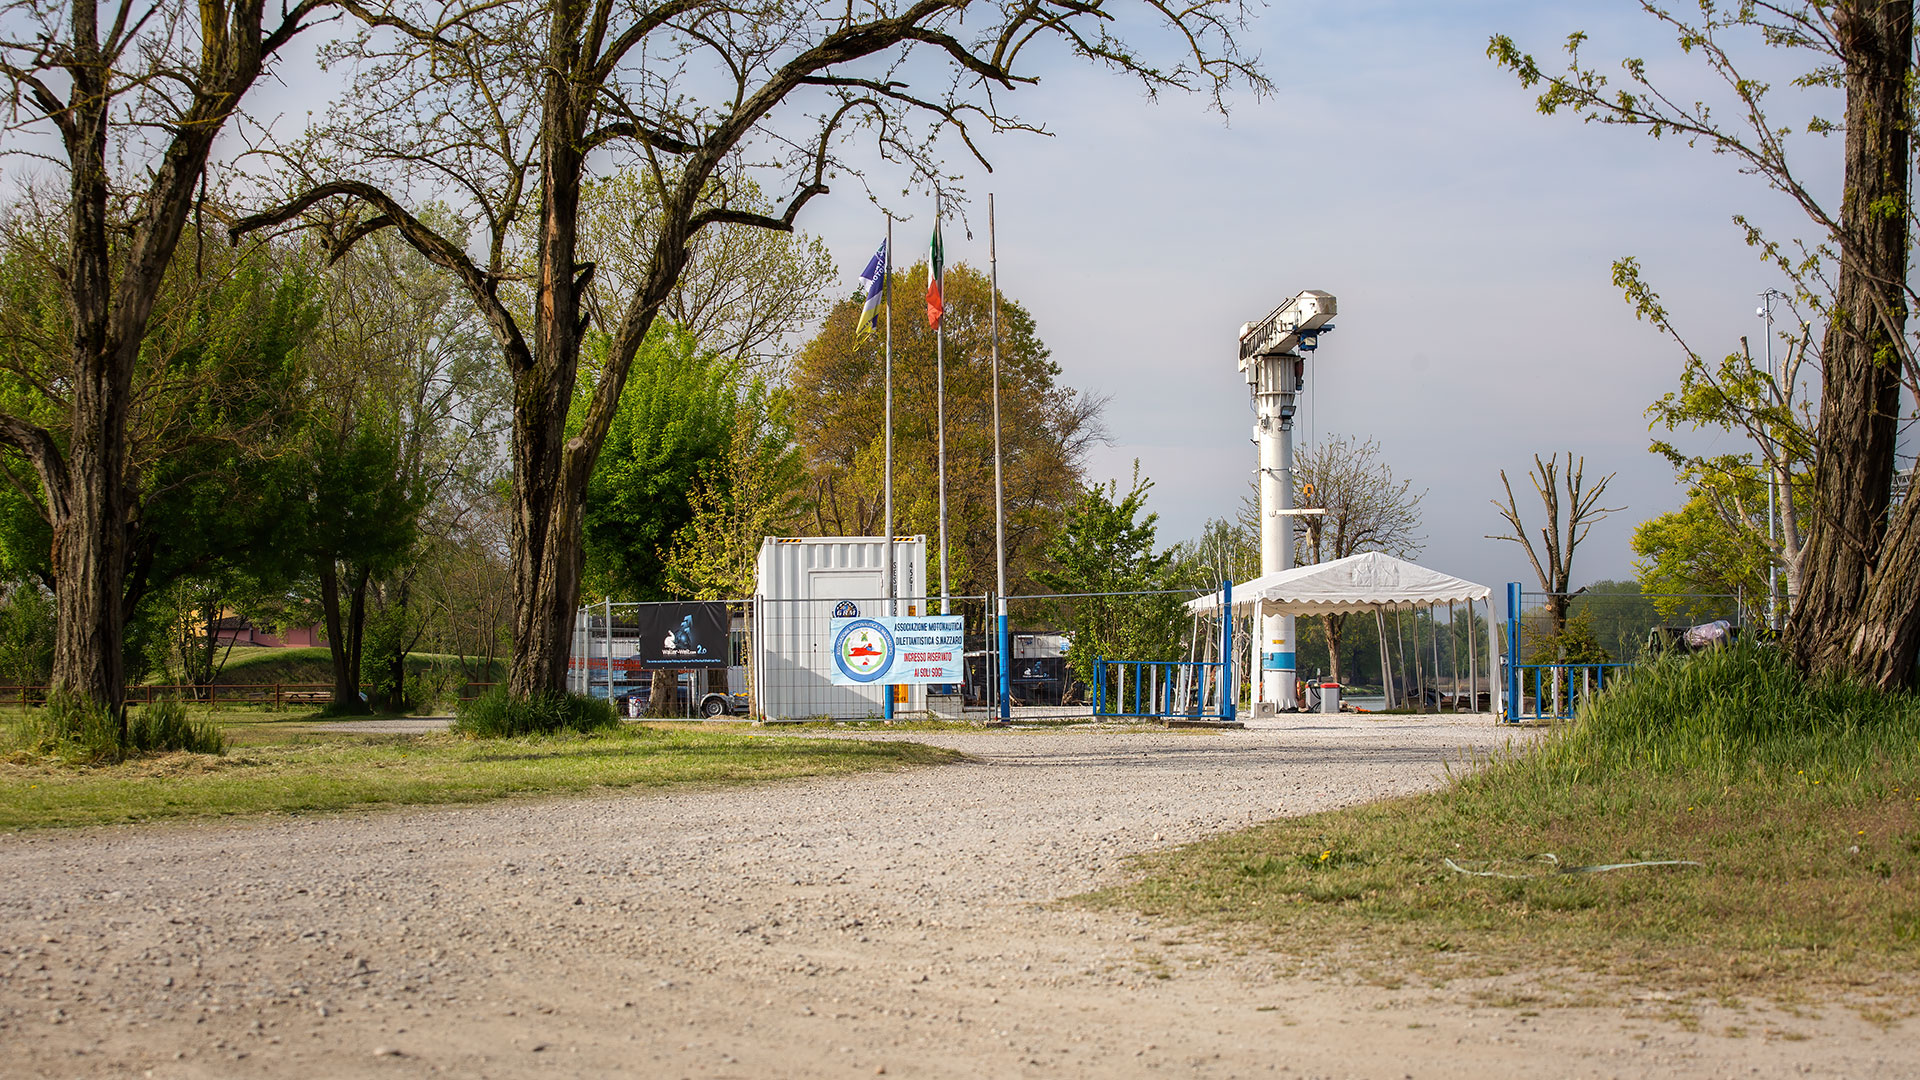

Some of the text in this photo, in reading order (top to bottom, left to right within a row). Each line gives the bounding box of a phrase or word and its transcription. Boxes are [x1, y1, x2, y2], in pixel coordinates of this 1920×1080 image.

[894, 622, 963, 632] ASSOCIAZIONE MOTONAUTICA
[895, 636, 935, 646] DILETTANTISTICA
[903, 652, 952, 662] INGRESSO RISERVATO
[914, 667, 943, 677] AI SOLI SOCI
